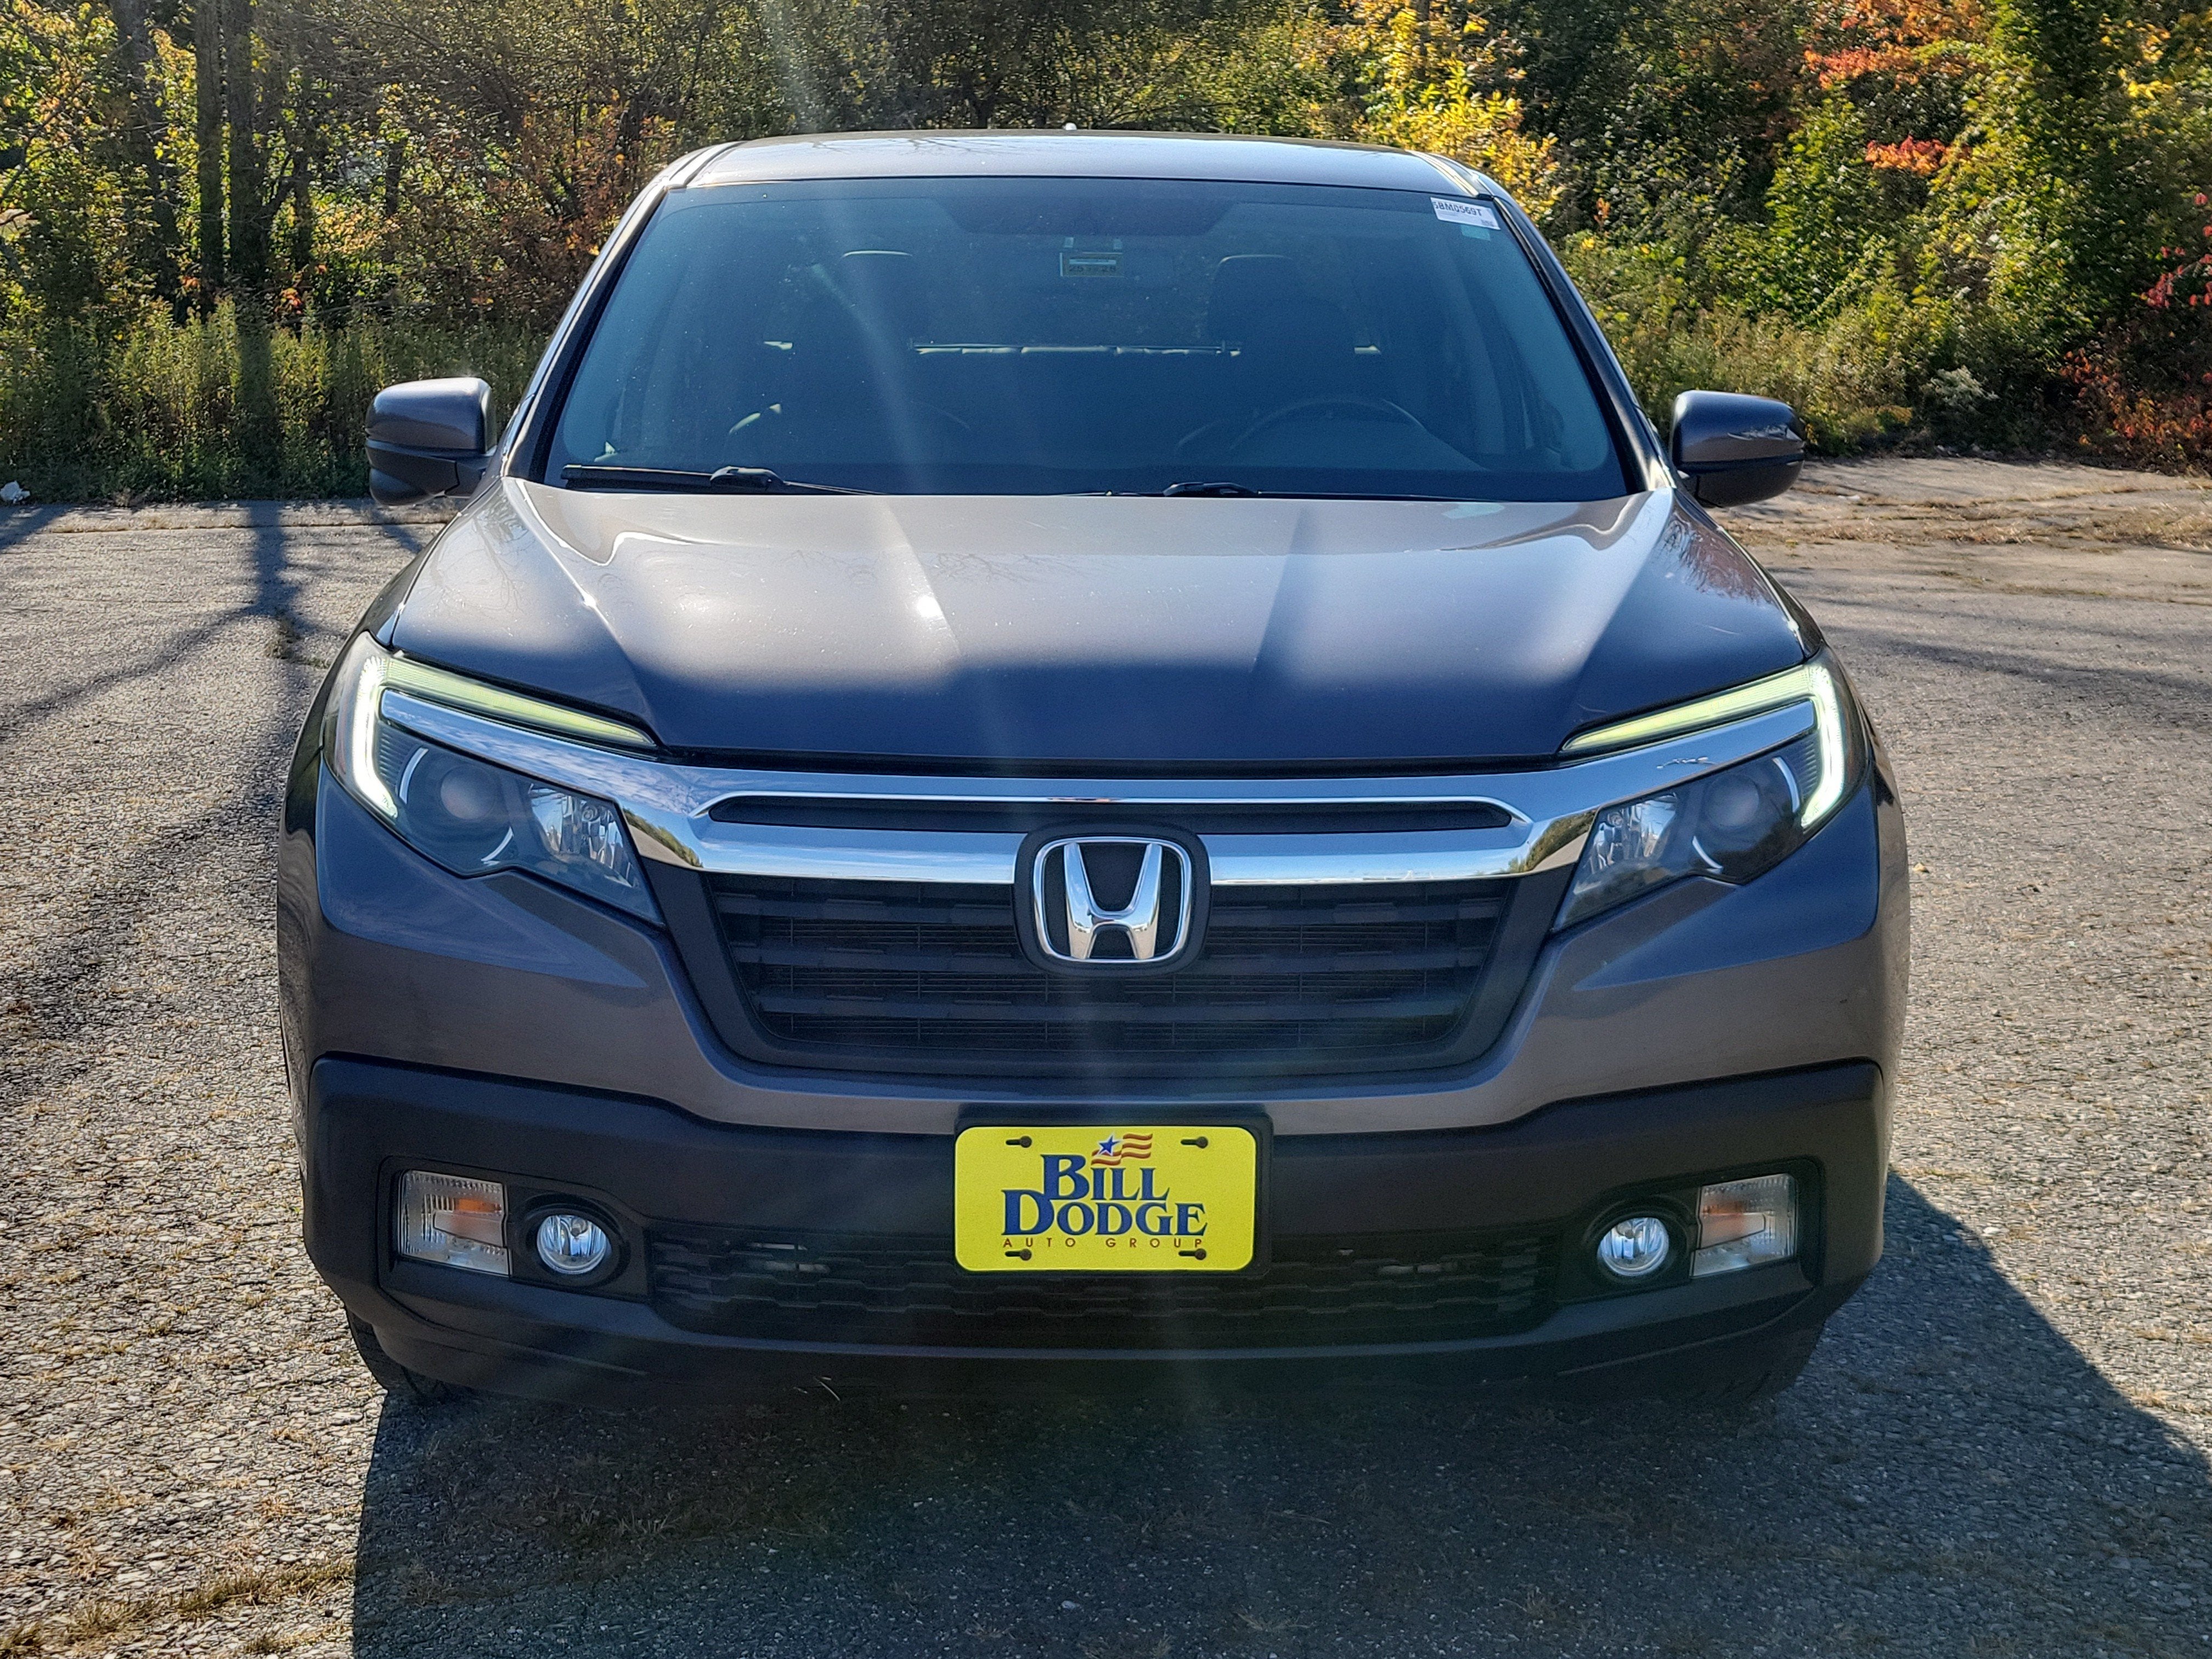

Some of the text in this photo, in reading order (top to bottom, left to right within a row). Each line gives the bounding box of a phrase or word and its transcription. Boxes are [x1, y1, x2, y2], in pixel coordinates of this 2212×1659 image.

[1040, 1154, 1170, 1201] BILL
[1001, 1189, 1208, 1236] DODGE
[1003, 1237, 1203, 1248] AUTO GROUP
